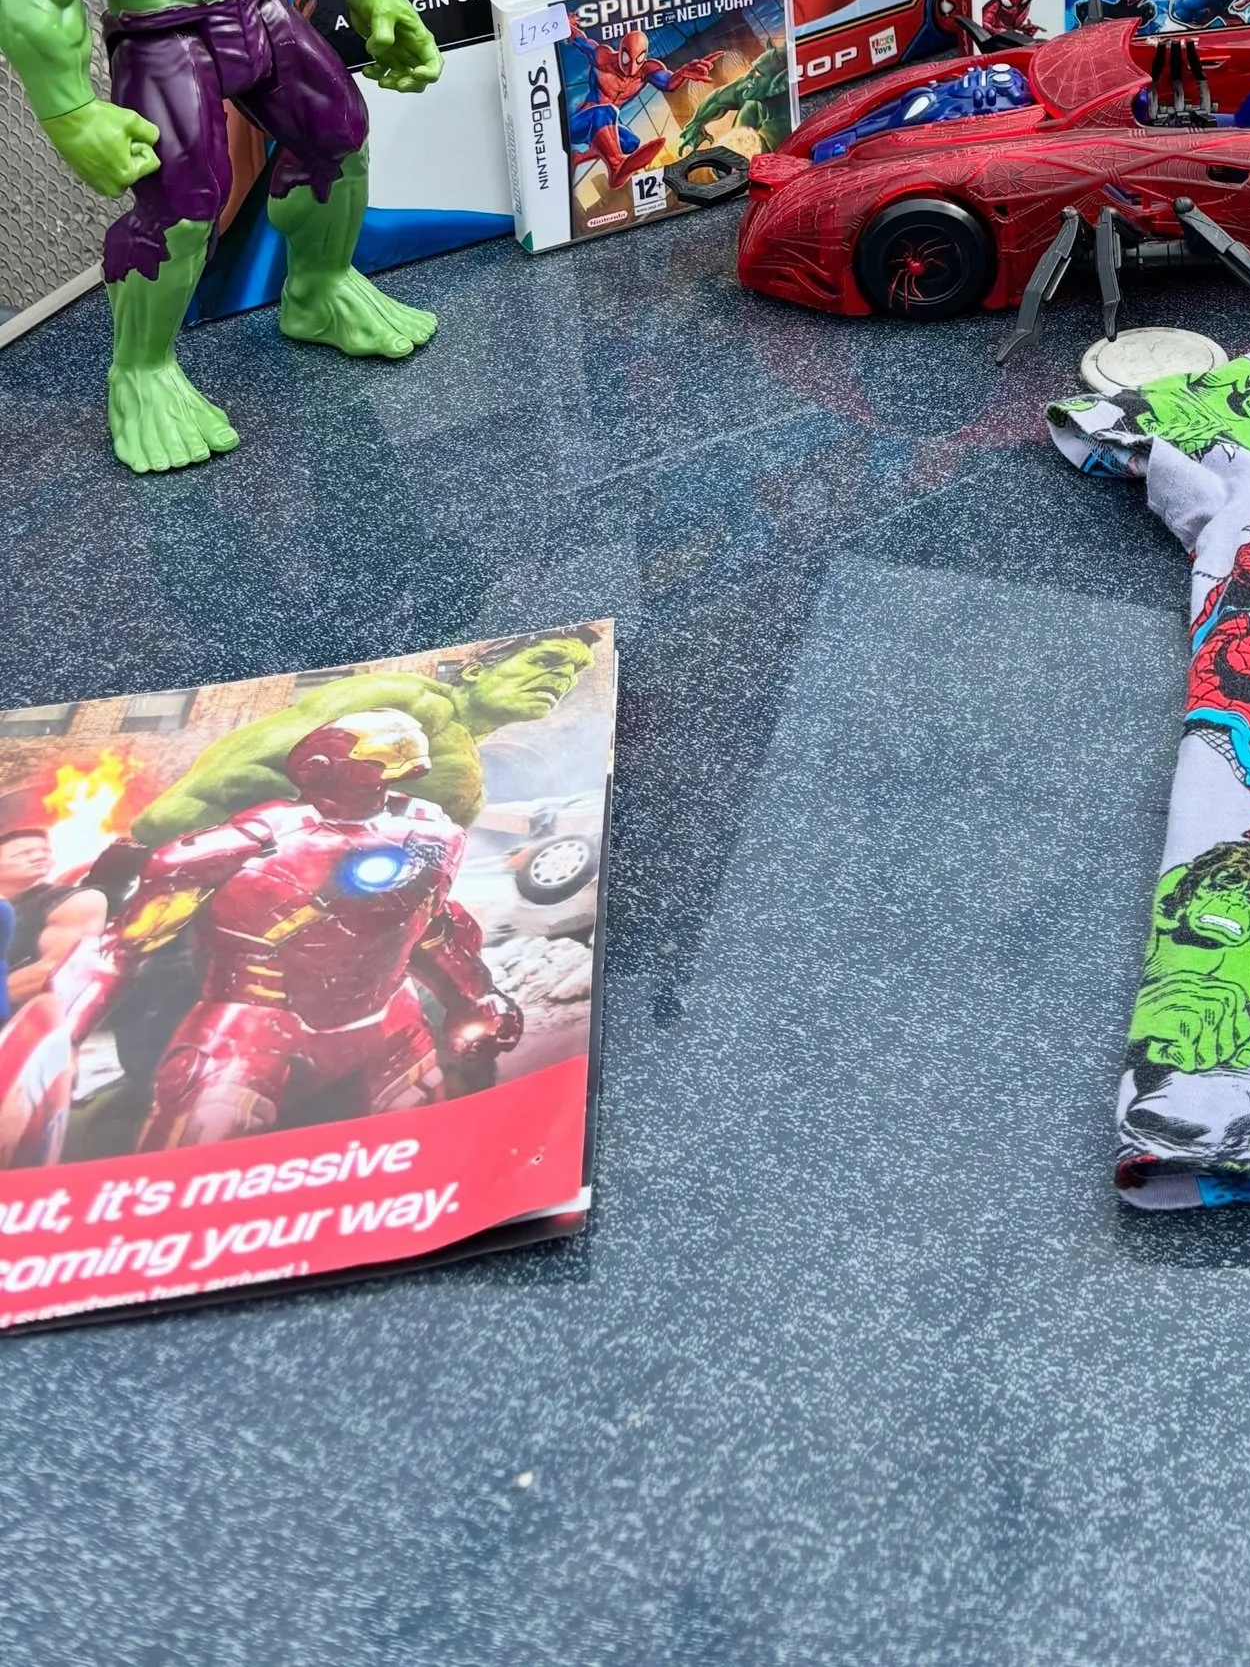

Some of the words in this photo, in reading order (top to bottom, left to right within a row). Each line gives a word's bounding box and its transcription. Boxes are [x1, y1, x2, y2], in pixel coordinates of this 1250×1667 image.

[334, 14, 350, 31] A
[601, 12, 665, 40] BATTLE
[676, 1, 712, 23] NEW
[795, 46, 858, 82] OP
[874, 44, 892, 56] Toys
[634, 174, 664, 201] 12+
[589, 210, 628, 228] Nintendo
[0, 1189, 72, 1236] ut,
[86, 1176, 175, 1226] it's
[182, 1138, 420, 1210] massive
[190, 1206, 333, 1271] your
[338, 1182, 460, 1232] way.
